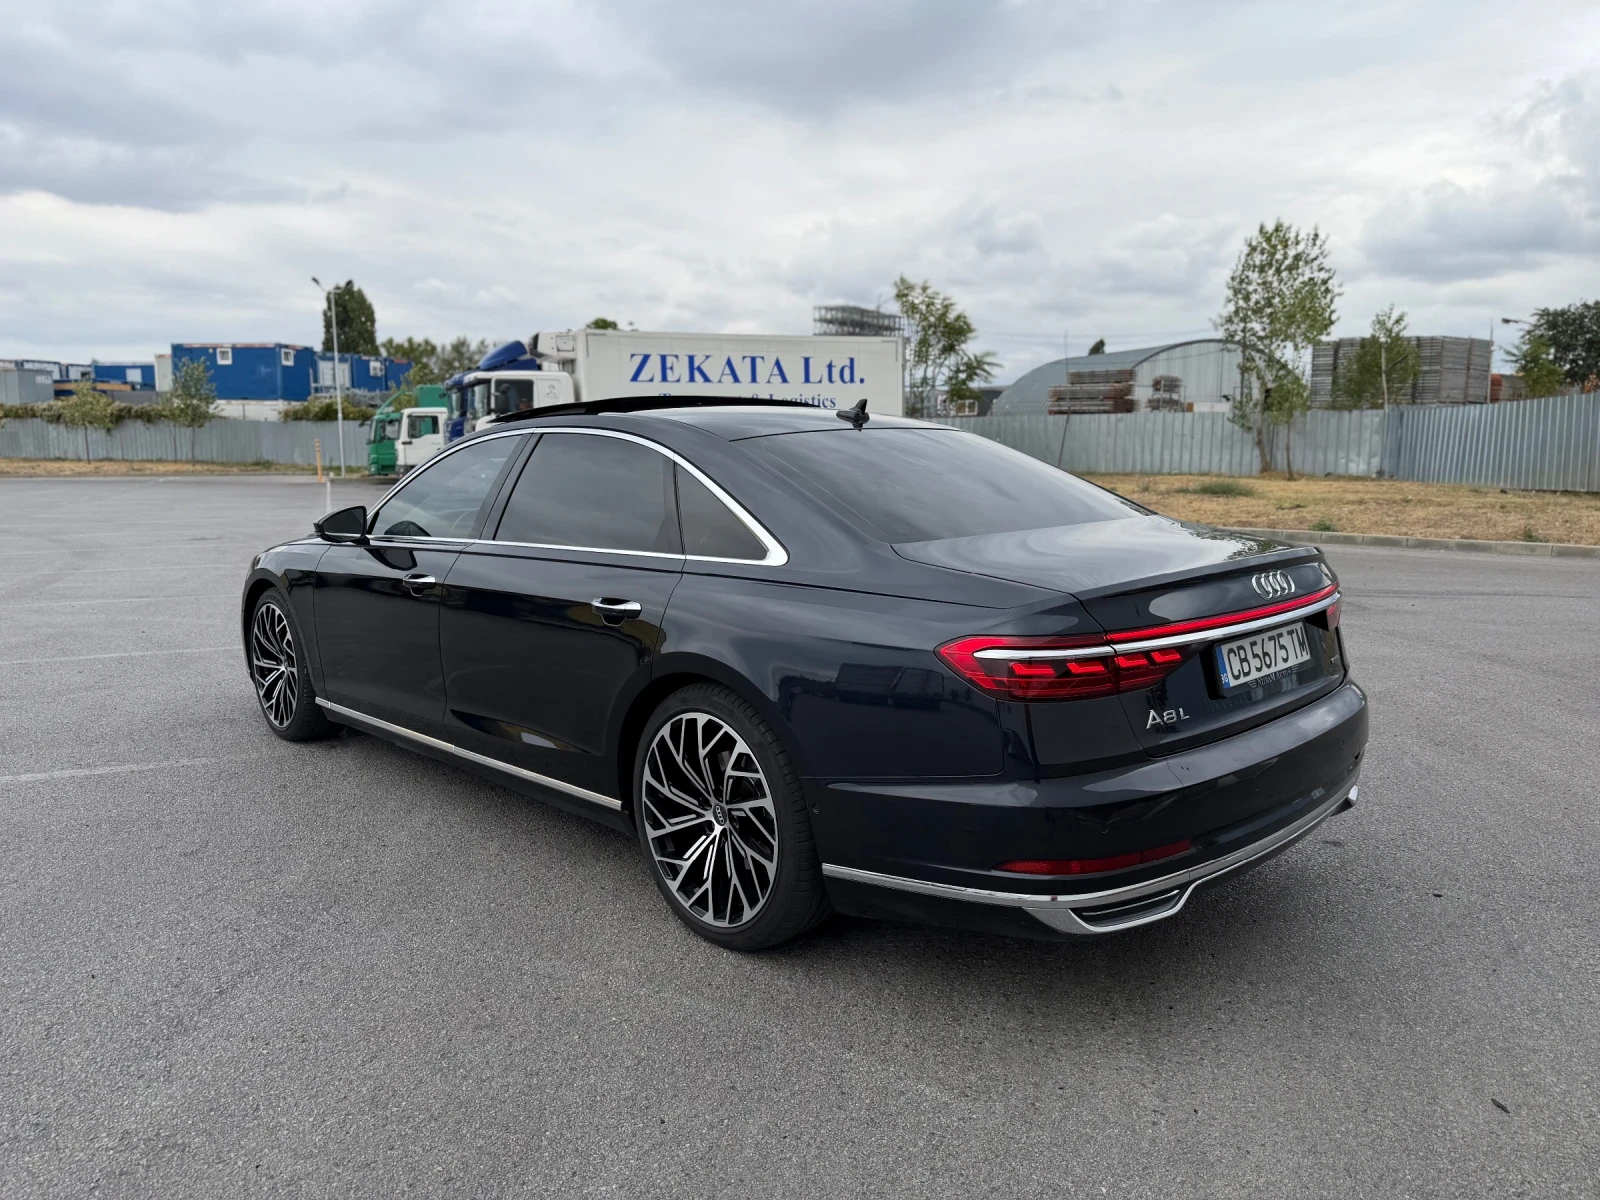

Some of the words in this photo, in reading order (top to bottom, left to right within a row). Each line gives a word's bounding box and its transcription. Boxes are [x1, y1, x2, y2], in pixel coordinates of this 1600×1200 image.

[629, 353, 790, 384] ZEKATA
[801, 356, 866, 385] Ltd.
[1145, 707, 1190, 730] A8L
